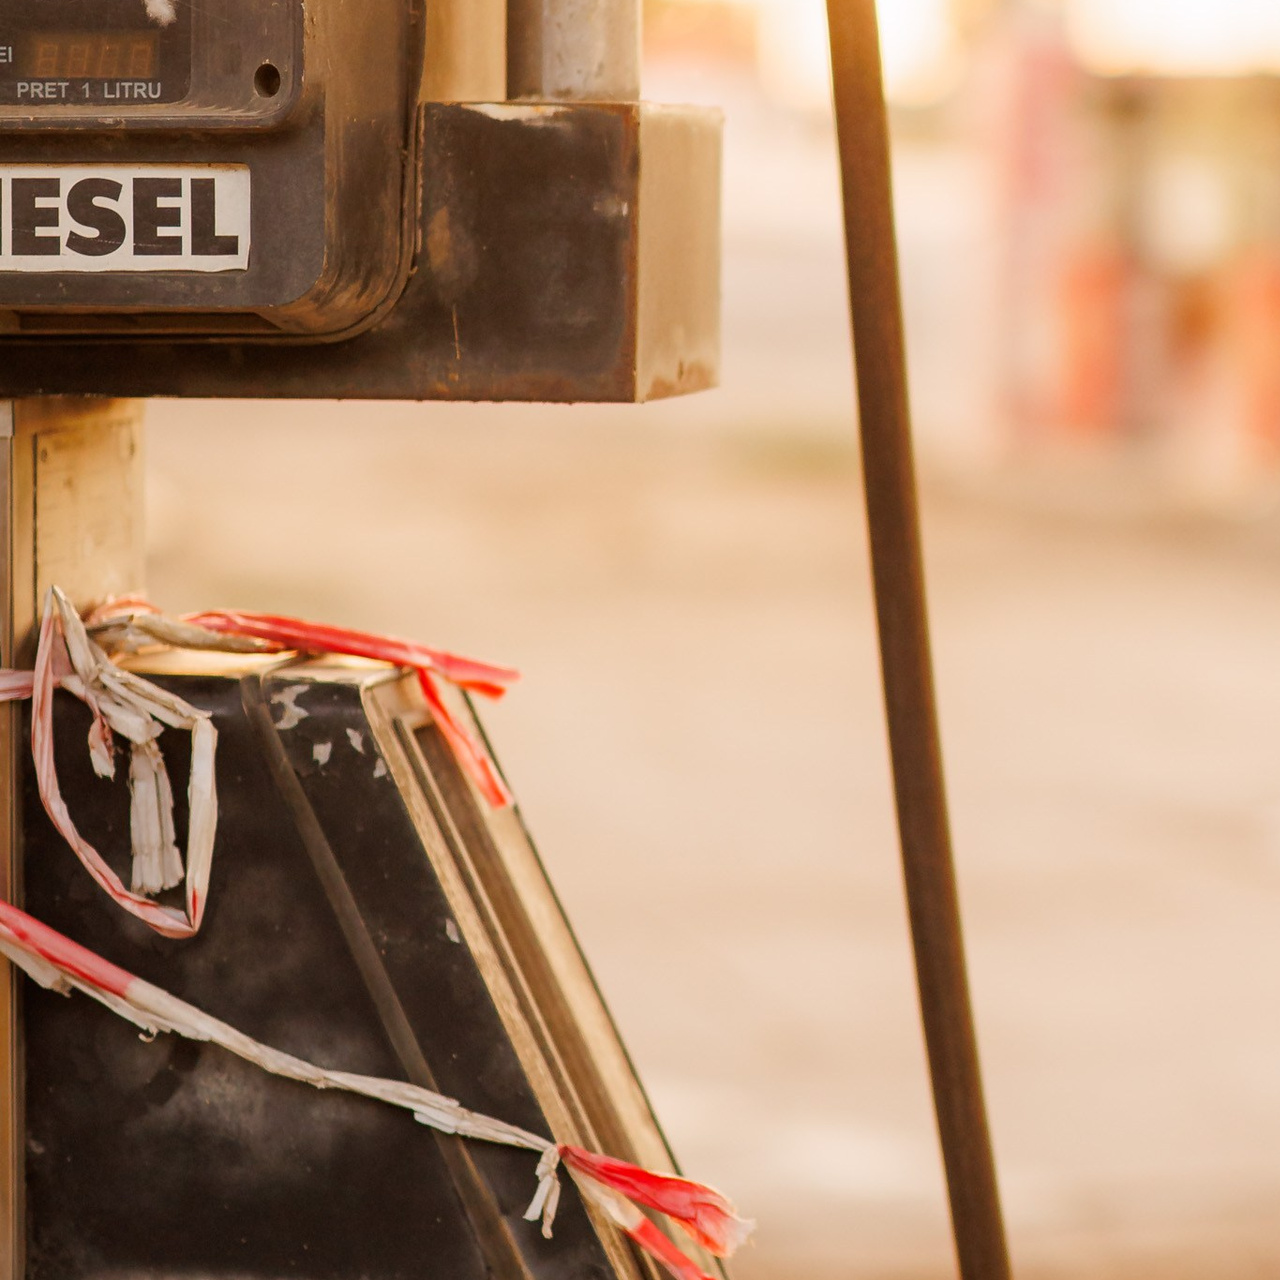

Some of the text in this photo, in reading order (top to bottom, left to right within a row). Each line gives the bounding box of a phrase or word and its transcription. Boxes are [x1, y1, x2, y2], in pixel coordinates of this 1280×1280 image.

[16, 81, 162, 99] PRET 1 LITRU
[0, 177, 239, 257] ESEL
